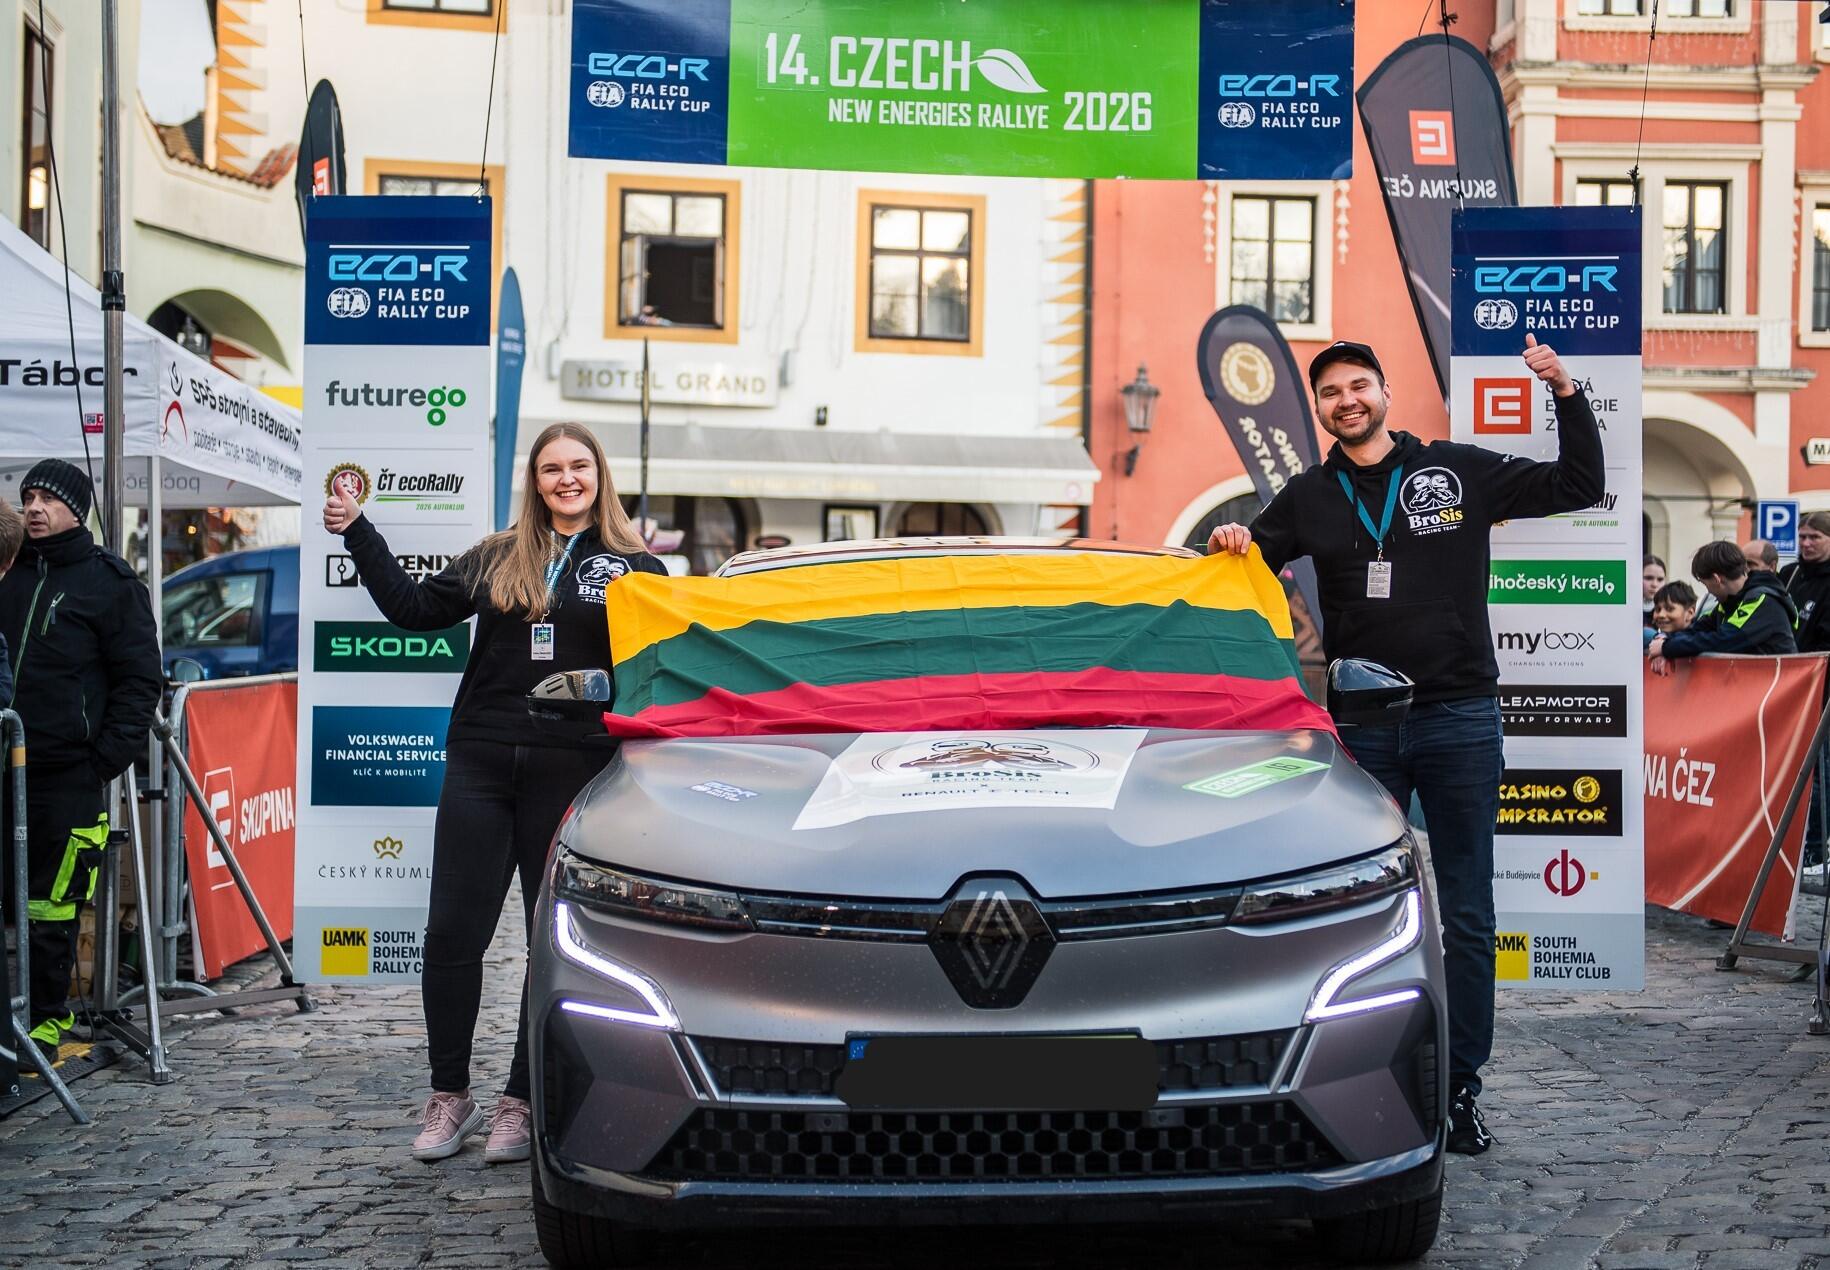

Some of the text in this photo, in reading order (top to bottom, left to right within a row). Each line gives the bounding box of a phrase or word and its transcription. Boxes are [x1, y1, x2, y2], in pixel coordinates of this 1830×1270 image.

[765, 33, 970, 91] 14. CZECH
[631, 83, 689, 97] FIA ECO
[630, 98, 710, 113] RALLY CUP
[828, 91, 1152, 131] NEW ENERGIES RALLYE 2026
[1262, 102, 1320, 114] FIA ECO
[1261, 116, 1341, 128] RALLY CUP
[378, 288, 445, 301] FIA ECO
[378, 305, 470, 319] RALLY CUP
[1526, 299, 1594, 312] FIA ECO
[1525, 315, 1620, 329] RALLY CUP
[676, 372, 766, 394] GRAND
[1545, 399, 1618, 412] EGIE
[377, 468, 464, 493] ČT ecoRally
[1408, 507, 1463, 529] BroSis
[1766, 505, 1790, 539] P
[1418, 528, 1442, 536] RACING
[1489, 573, 1604, 593] ihočeský kraj
[577, 584, 606, 597] Bro
[1497, 627, 1595, 655] mybox
[1500, 696, 1610, 708] LEAPMOTOR
[1545, 716, 1612, 724] FORWARD
[348, 734, 434, 746] VOLKSWAGEN
[325, 750, 447, 762] FINANCIAL SERVICE
[353, 767, 372, 776] KLÍČ
[1672, 747, 1716, 807] ČEZ
[902, 789, 980, 797] RENAULT
[1499, 784, 1567, 800] CASINO
[240, 786, 295, 845] SKUPINA
[318, 864, 431, 879] ČESKÝ KRUML
[1505, 870, 1541, 881] Budějovice
[322, 930, 367, 947] UAMK
[373, 931, 416, 944] SOUTH
[1495, 935, 1527, 951] AMK
[1533, 936, 1577, 949] SOUTH
[1534, 951, 1596, 964] BOHEMIA
[373, 961, 412, 974] RALLY
[1534, 966, 1611, 979] RALLY CLUB
